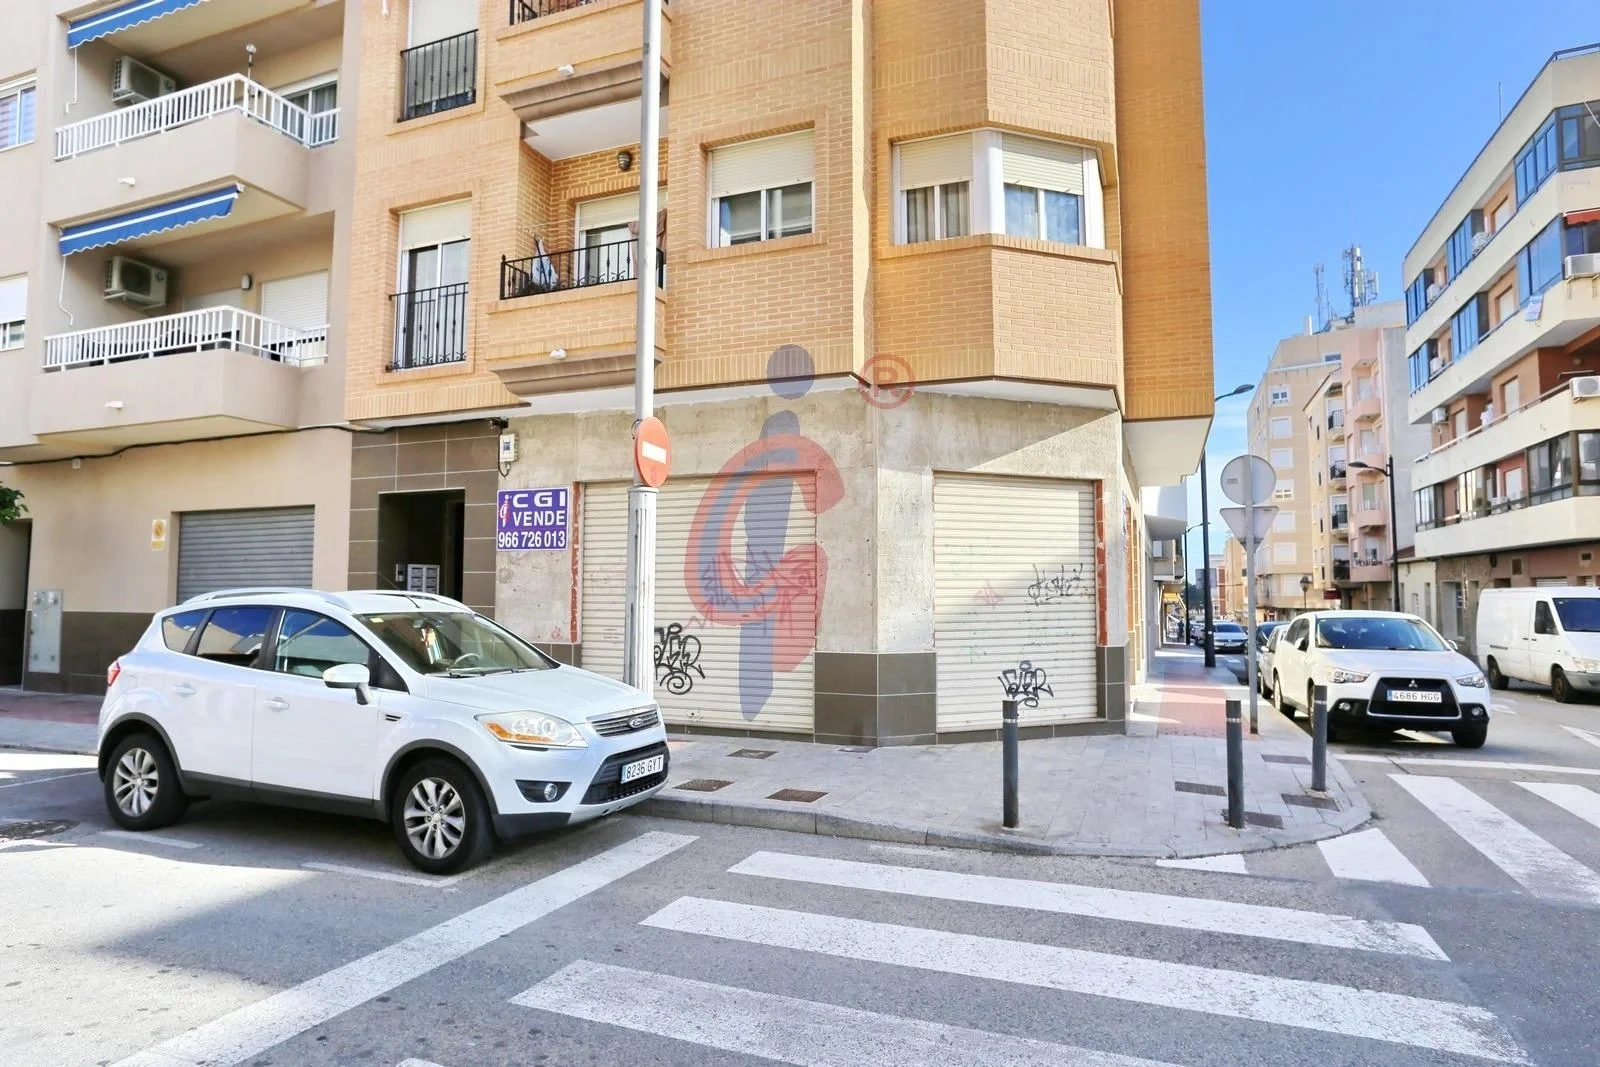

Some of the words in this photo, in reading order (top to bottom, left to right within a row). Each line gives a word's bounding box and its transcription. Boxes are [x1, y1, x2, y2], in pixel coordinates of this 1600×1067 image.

[512, 491, 566, 508] CGI
[512, 510, 566, 527] VENDE
[498, 531, 519, 548] 966
[521, 531, 542, 547] 726
[544, 530, 566, 547] 013
[1393, 692, 1418, 700] 4686
[626, 761, 646, 779] 8236
[647, 756, 663, 773] GYT
